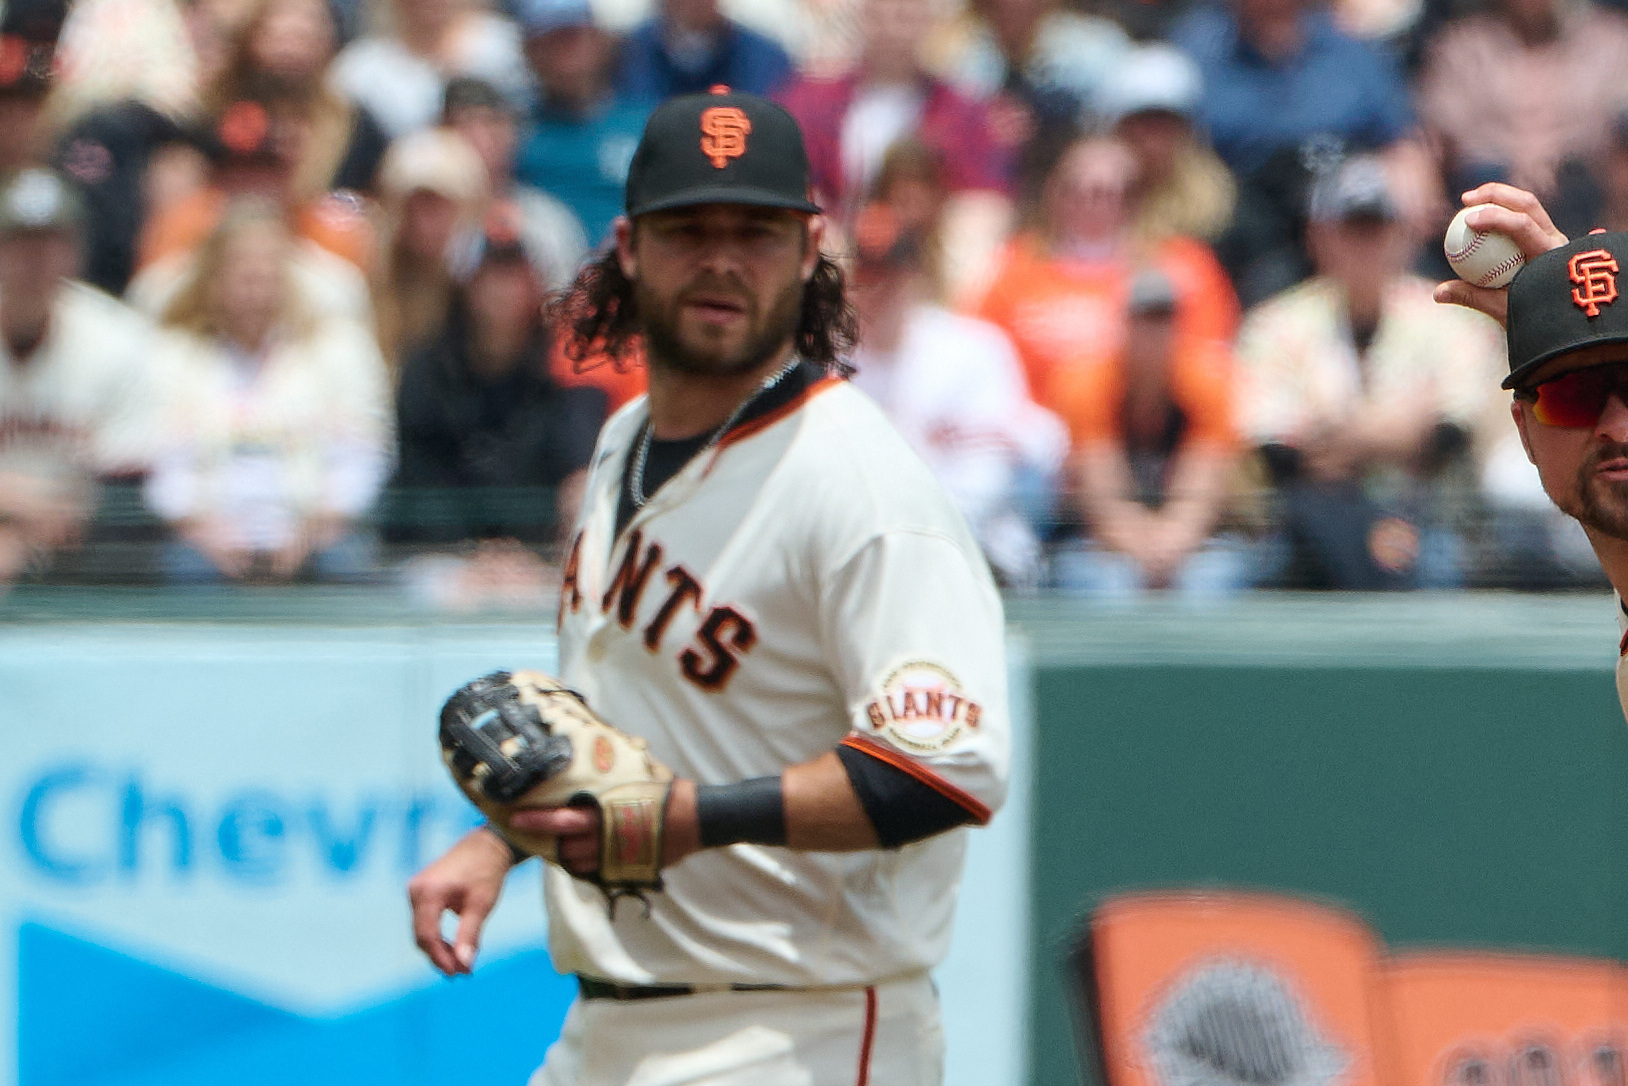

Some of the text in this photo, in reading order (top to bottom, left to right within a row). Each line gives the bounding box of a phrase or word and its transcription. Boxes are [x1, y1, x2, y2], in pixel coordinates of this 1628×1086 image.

[700, 106, 752, 170] SF
[1567, 248, 1619, 317] SF
[865, 689, 982, 730] GIANTS
[16, 762, 487, 882] Chevr
